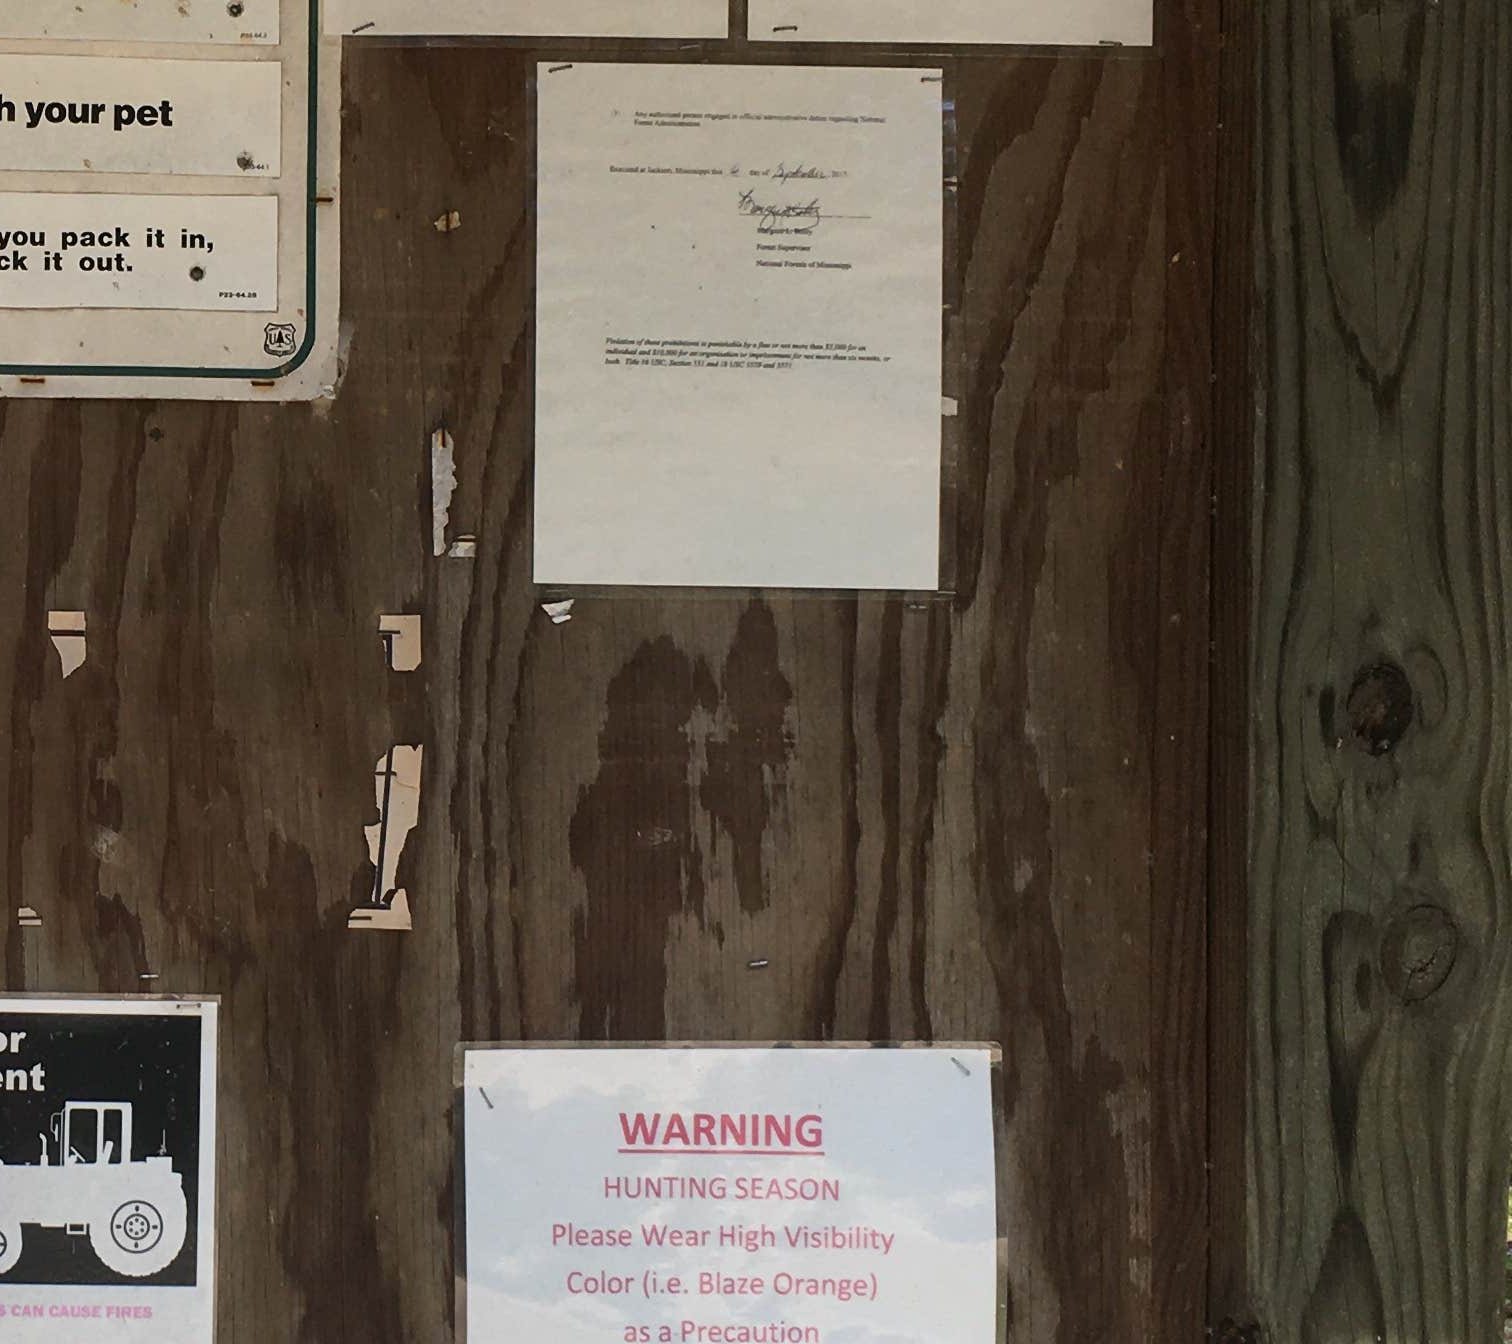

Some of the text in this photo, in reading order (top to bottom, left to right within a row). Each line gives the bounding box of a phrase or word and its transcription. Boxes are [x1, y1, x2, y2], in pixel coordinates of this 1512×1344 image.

[25, 101, 105, 128] your
[113, 100, 173, 131] pet
[61, 228, 130, 250] pack
[146, 229, 164, 247] it
[181, 230, 213, 253] in,
[44, 252, 62, 271] it
[79, 254, 133, 272] out.
[619, 1113, 823, 1147] WARNING
[604, 1176, 840, 1201] HUNTING SEASON
[552, 1223, 895, 1255] Please Wear High Visibility
[567, 1270, 878, 1301] Color (i.e. Blaze Orange)
[11, 1304, 44, 1317] CAN
[49, 1305, 101, 1318] CAUSE
[106, 1306, 153, 1319] FIRES
[624, 1320, 819, 1344] as a Precaution
